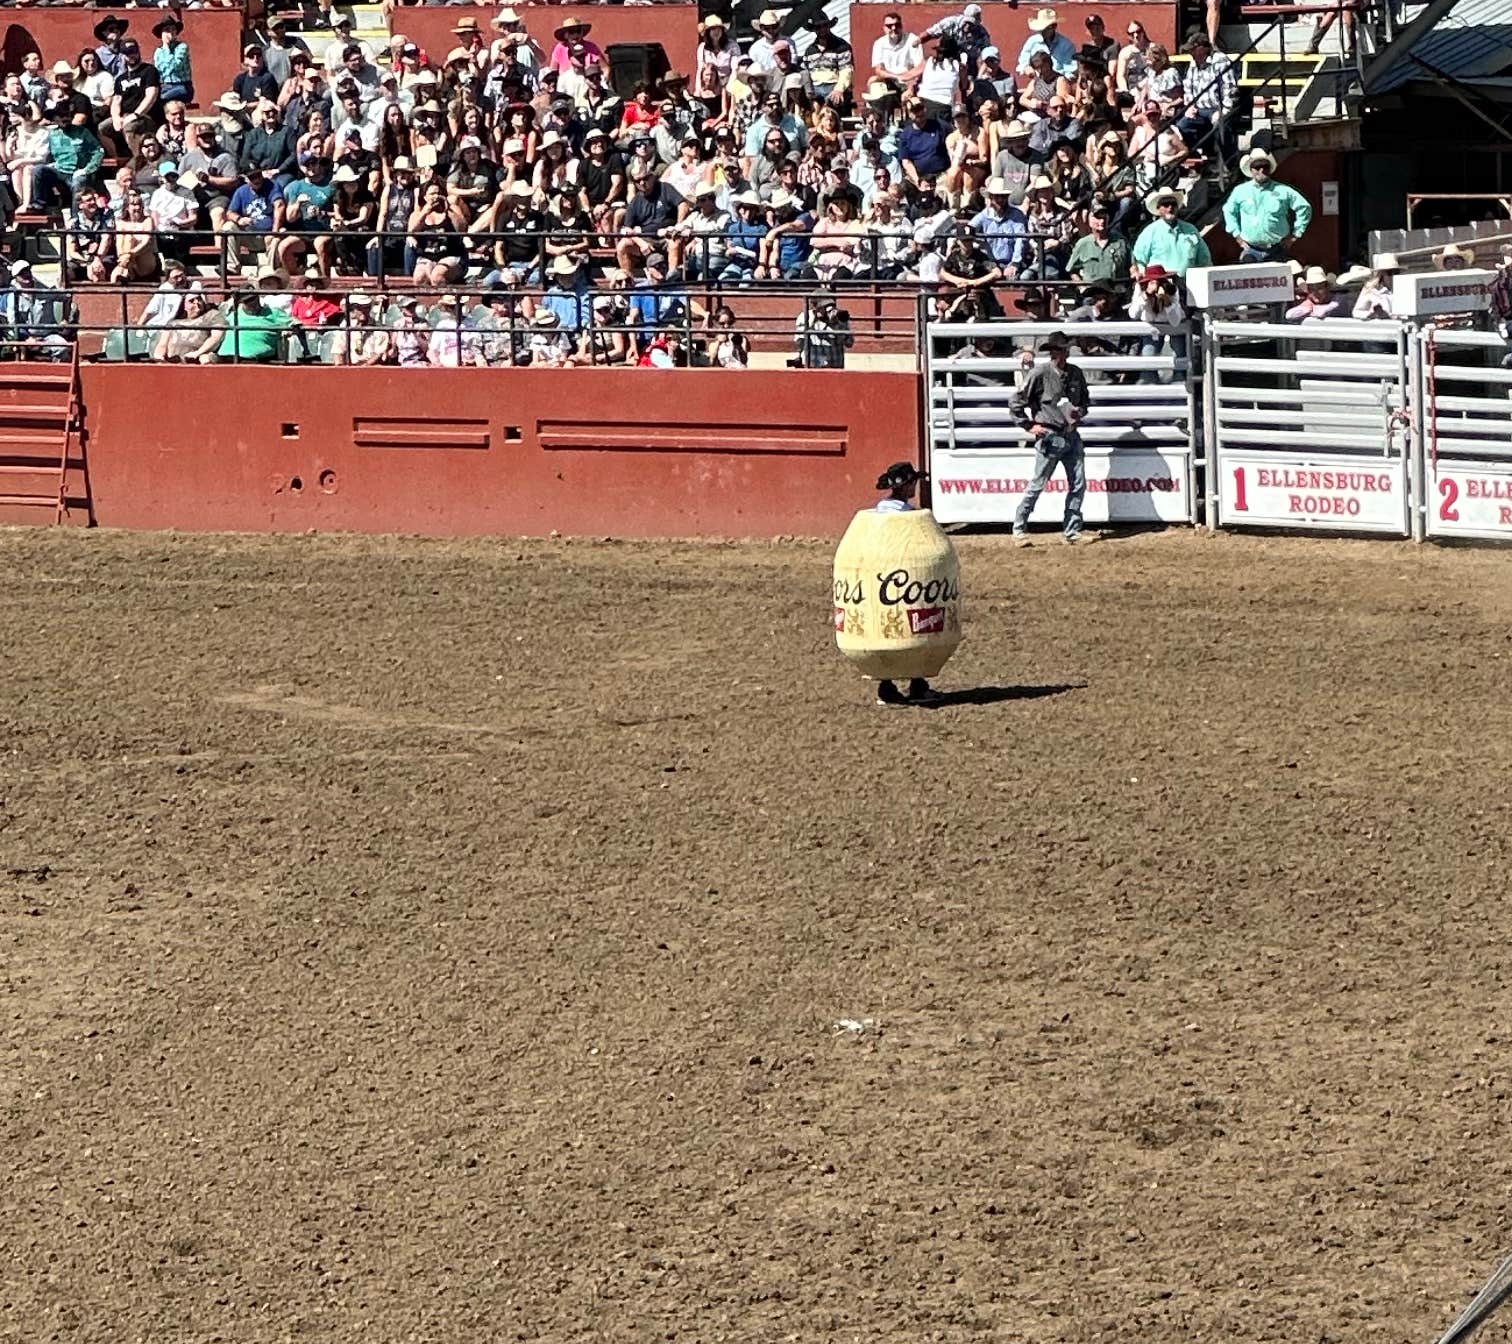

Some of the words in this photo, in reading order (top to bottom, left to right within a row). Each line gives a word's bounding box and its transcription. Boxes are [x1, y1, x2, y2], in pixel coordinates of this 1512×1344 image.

[1213, 275, 1288, 292] ELLENSBURG
[938, 478, 1181, 494] WWW.ELLEBURODEO.COM
[1233, 467, 1249, 512] 1
[1257, 468, 1392, 493] ELLENSBURG
[1438, 477, 1460, 522] 2
[1288, 494, 1361, 516] RODEO
[835, 576, 866, 605] ors
[876, 569, 960, 606] Coors
